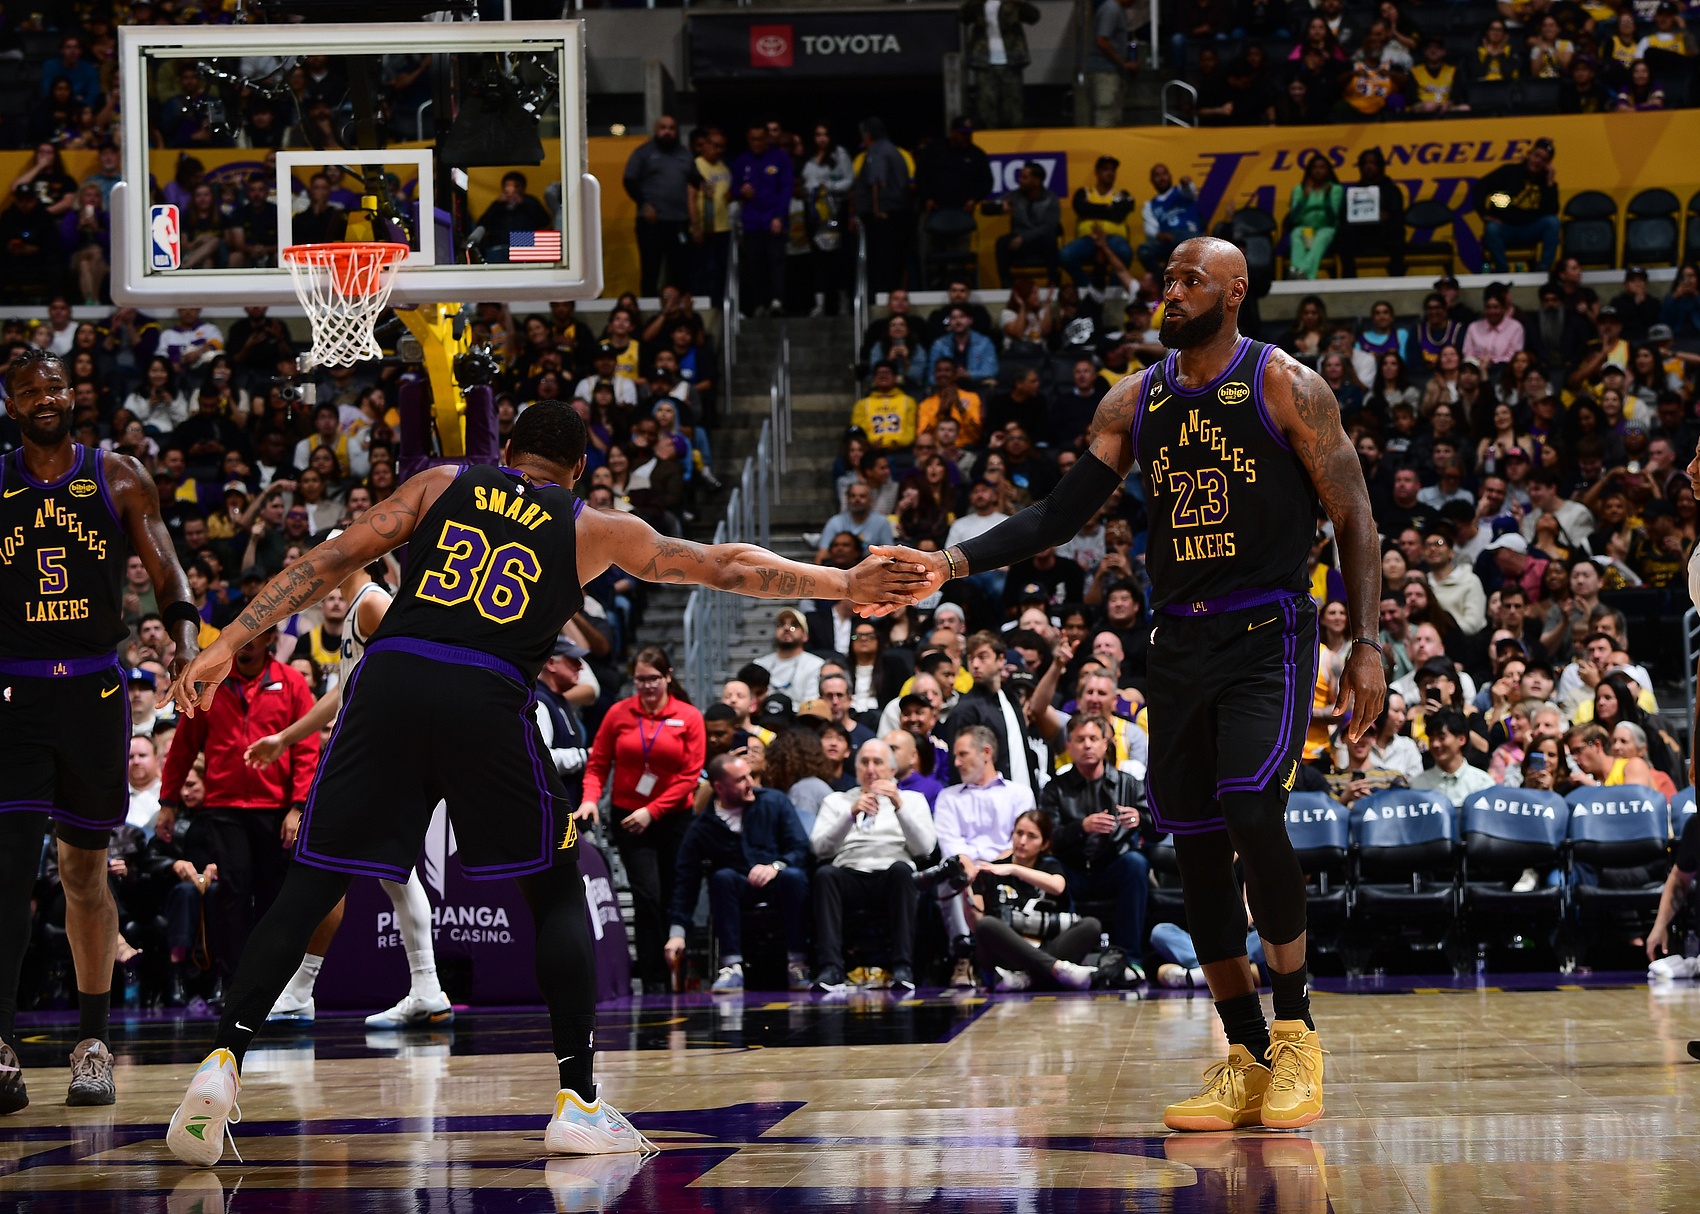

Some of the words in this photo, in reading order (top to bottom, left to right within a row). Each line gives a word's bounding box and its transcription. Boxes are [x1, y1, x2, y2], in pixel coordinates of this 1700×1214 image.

[802, 34, 901, 55] TOYOTA
[1270, 146, 1348, 172] LOS
[1354, 138, 1532, 168] NGELE
[1220, 387, 1248, 398] bibigo
[871, 413, 901, 434] 23
[1150, 446, 1170, 497] LOS
[1178, 409, 1257, 484] ANGELES
[71, 483, 97, 492] bibigo
[1168, 467, 1230, 529] 23
[474, 485, 553, 531] SMART
[34, 498, 107, 560] ANGELES
[1172, 532, 1236, 562] LAKERS
[37, 546, 69, 595] 5
[415, 519, 543, 625] 36
[25, 598, 89, 622] LAKERS
[1284, 808, 1338, 824] ELTA
[1381, 802, 1444, 820] DELTA
[1493, 799, 1556, 820] DELTA
[1591, 799, 1655, 815] DELTA
[377, 906, 510, 933] PEHANGA
[450, 928, 512, 944] CASINO
